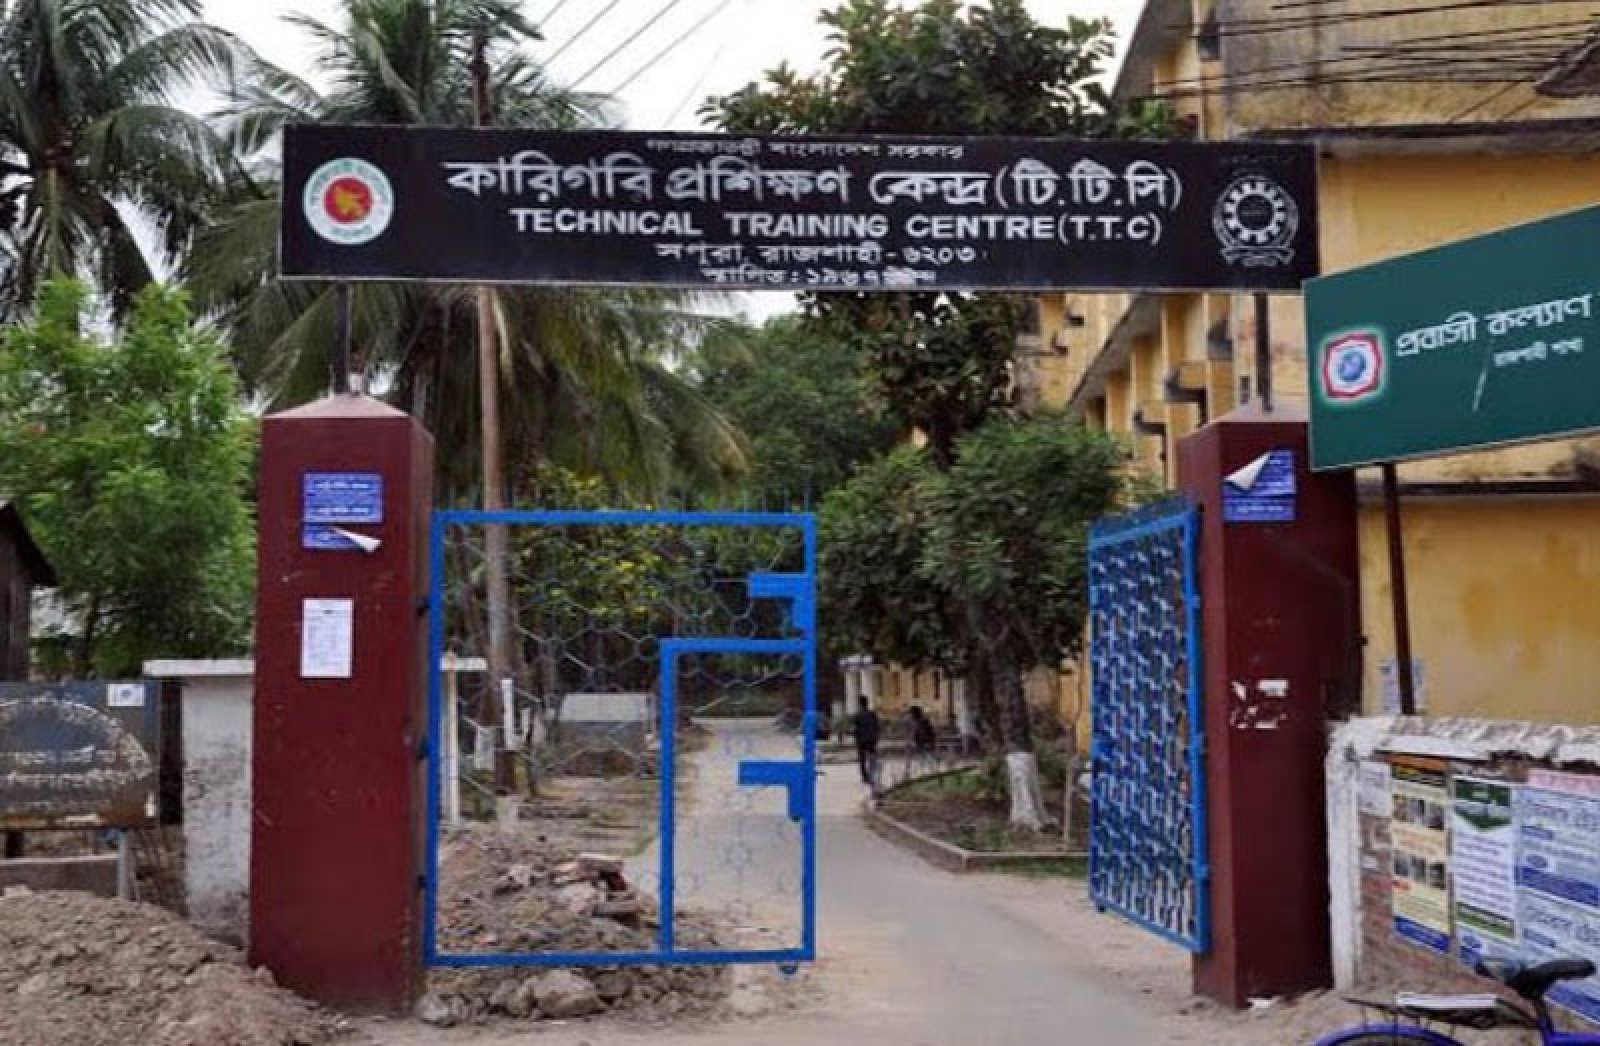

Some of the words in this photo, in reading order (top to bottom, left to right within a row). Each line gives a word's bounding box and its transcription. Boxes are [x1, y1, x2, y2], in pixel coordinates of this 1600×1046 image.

[440, 150, 657, 202] কারিগরি
[665, 155, 852, 203] প্রশিক্ষণ
[508, 207, 703, 236] TECHNICAL
[724, 212, 889, 238] TRAINING
[756, 241, 882, 264] রাজশাহী
[1395, 311, 1479, 356] প্রবাসী
[1484, 293, 1593, 335] কল্যাণ
